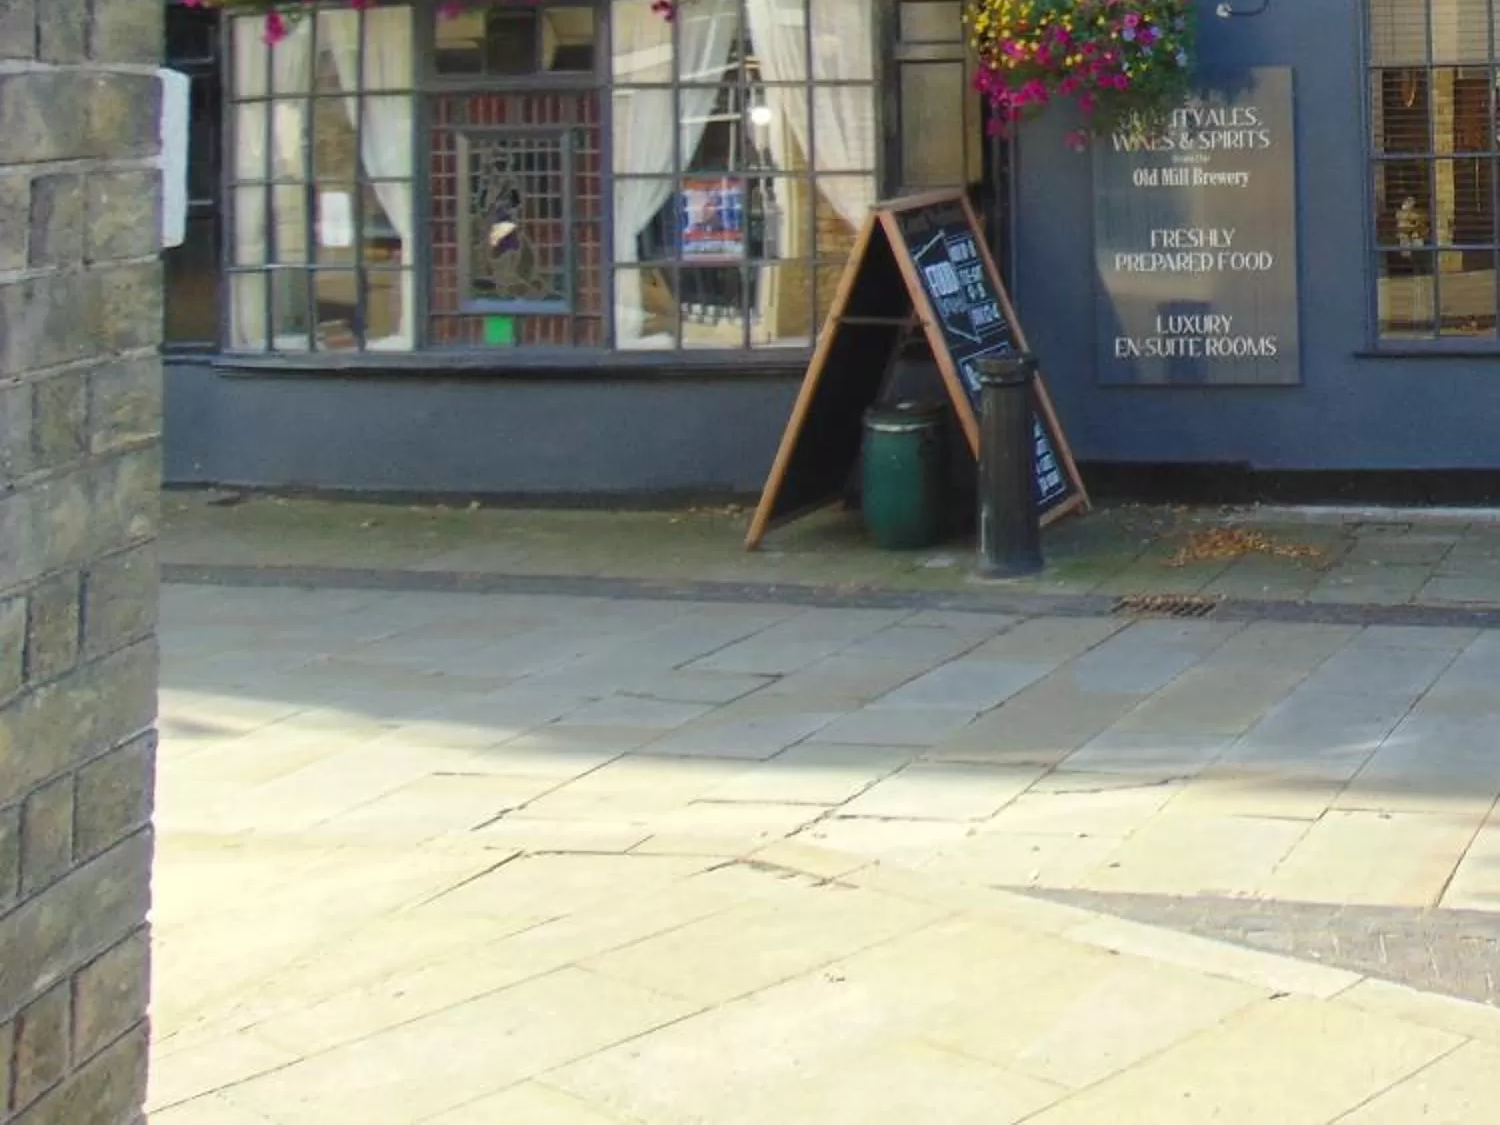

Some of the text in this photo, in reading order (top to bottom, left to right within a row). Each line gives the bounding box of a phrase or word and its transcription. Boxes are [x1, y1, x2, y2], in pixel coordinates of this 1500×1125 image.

[1179, 131, 1194, 150] &
[1199, 129, 1270, 150] SPIRITS
[1133, 166, 1251, 188] Old Mill Brewery
[1150, 226, 1237, 248] FRESHLY
[1115, 250, 1274, 273] PREPARED FOOD
[1156, 313, 1233, 335] LUXURY
[1205, 335, 1278, 357] ROOMS
